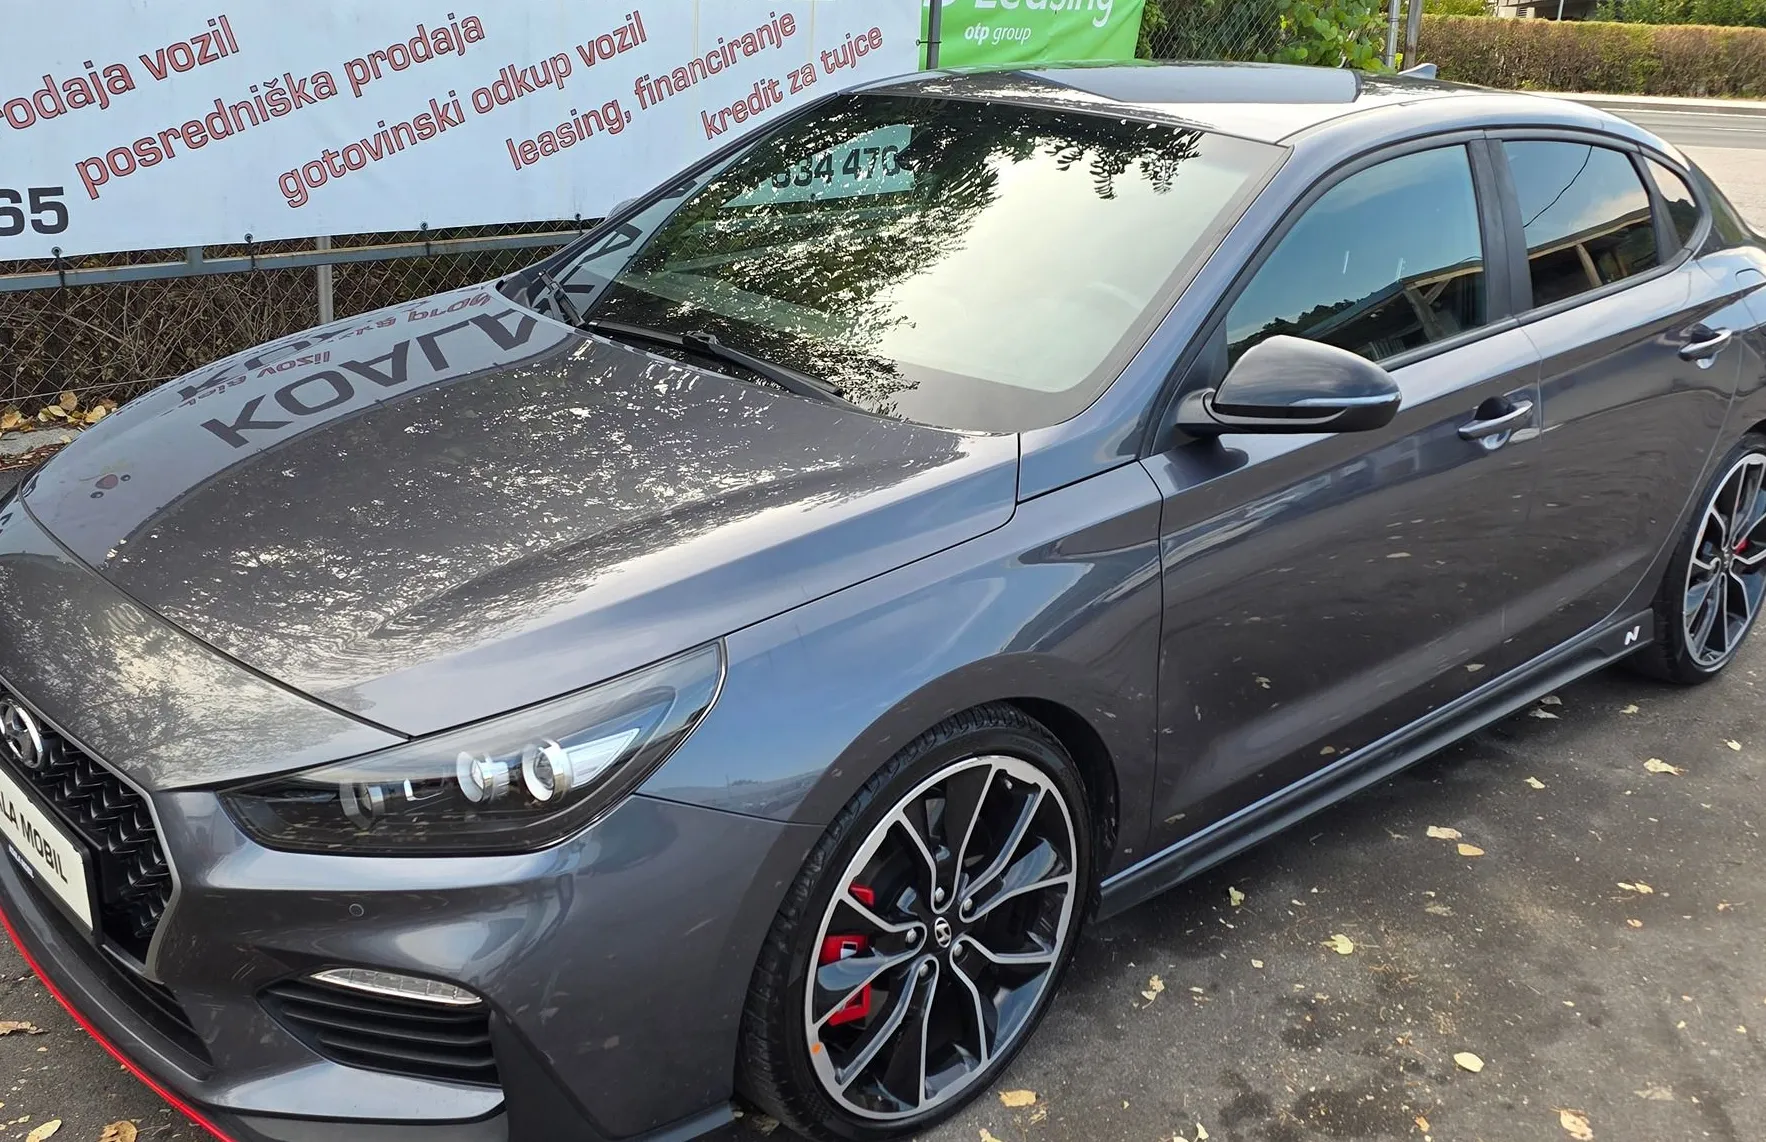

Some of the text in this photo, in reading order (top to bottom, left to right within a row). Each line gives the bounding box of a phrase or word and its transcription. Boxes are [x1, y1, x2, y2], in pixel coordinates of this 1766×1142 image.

[0, 14, 240, 129] odaja vozil
[505, 11, 796, 171] leasing, financiranje
[700, 26, 883, 140] kredit za tujce
[964, 22, 1032, 46] otp group
[75, 12, 485, 200] posredniška prodaja
[278, 10, 647, 208] gotovinski odkup vozil
[1624, 625, 1640, 645] N
[20, 812, 69, 885] MOBIL
